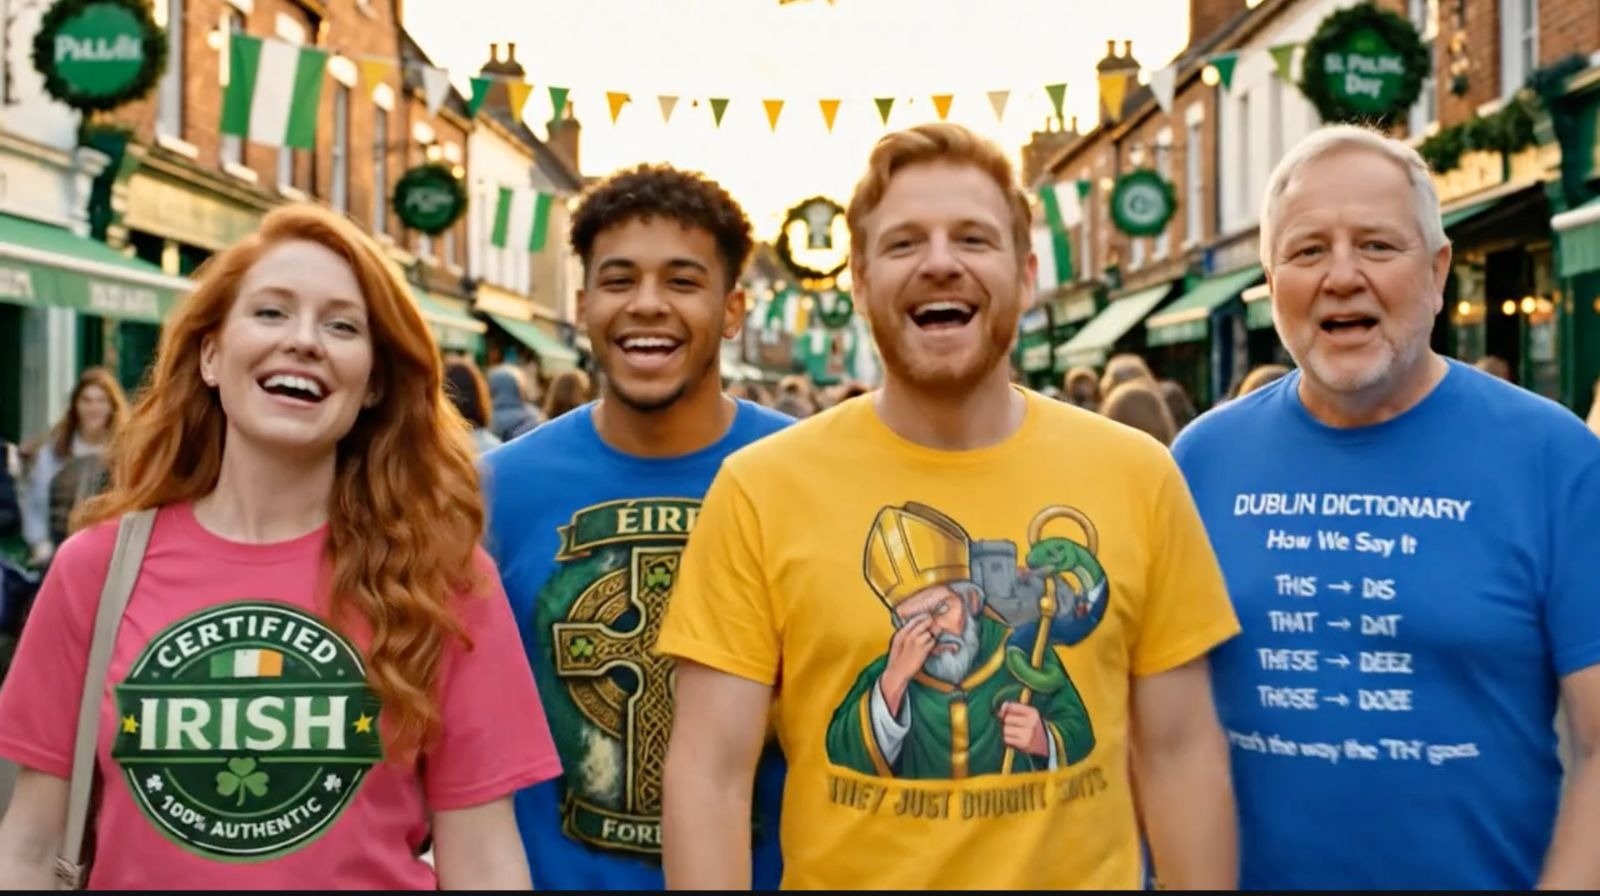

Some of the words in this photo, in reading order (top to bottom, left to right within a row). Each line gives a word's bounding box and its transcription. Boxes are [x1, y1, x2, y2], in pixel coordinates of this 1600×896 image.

[1234, 493, 1315, 516] DUBLIN
[1322, 494, 1471, 521] DICTIONARY
[1266, 529, 1311, 549] How
[1318, 530, 1350, 550] We
[1355, 532, 1395, 557] Say
[1401, 534, 1418, 555] It
[1275, 574, 1317, 597] THIS
[1362, 577, 1396, 600] DIS
[1268, 611, 1319, 633] THAT
[1361, 614, 1402, 638] DAT
[157, 616, 337, 668] CERTIFIED
[1359, 652, 1413, 674] DEEZ
[1257, 685, 1318, 710] THOSE
[139, 696, 349, 751] IRISH
[895, 786, 954, 819] JUST
[161, 795, 206, 832] 100%
[210, 797, 322, 839] AUTHENTIC
